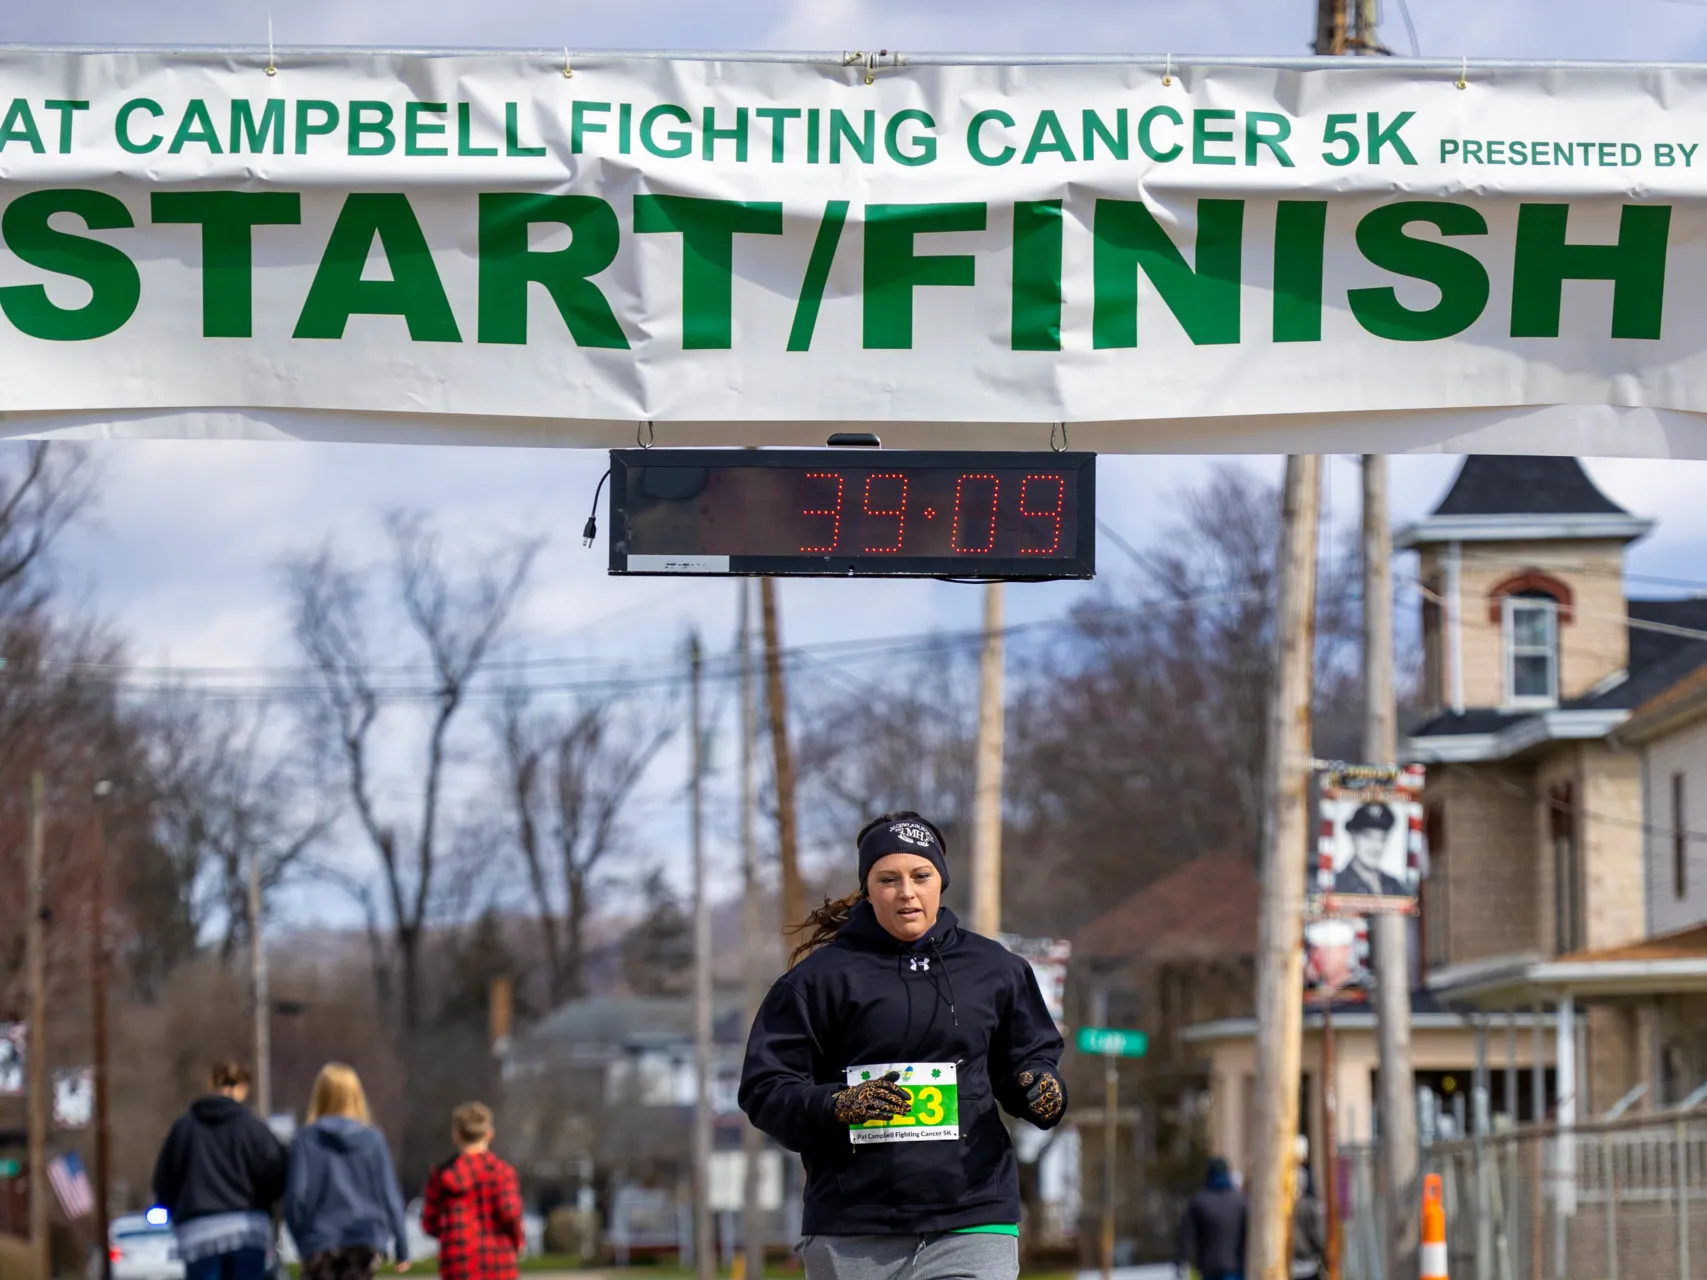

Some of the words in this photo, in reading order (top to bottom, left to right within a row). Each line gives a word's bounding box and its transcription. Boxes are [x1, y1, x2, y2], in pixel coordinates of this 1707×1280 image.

[115, 98, 547, 157] CAMPBELL
[571, 101, 937, 167] FIGHTING
[966, 105, 1295, 168] CANCER
[1322, 111, 1418, 167] 5K
[1440, 139, 1642, 167] PRESENTED
[1654, 143, 1699, 168] BY
[0, 189, 1672, 352] START/FINISH
[867, 1132, 895, 1140] Campbell
